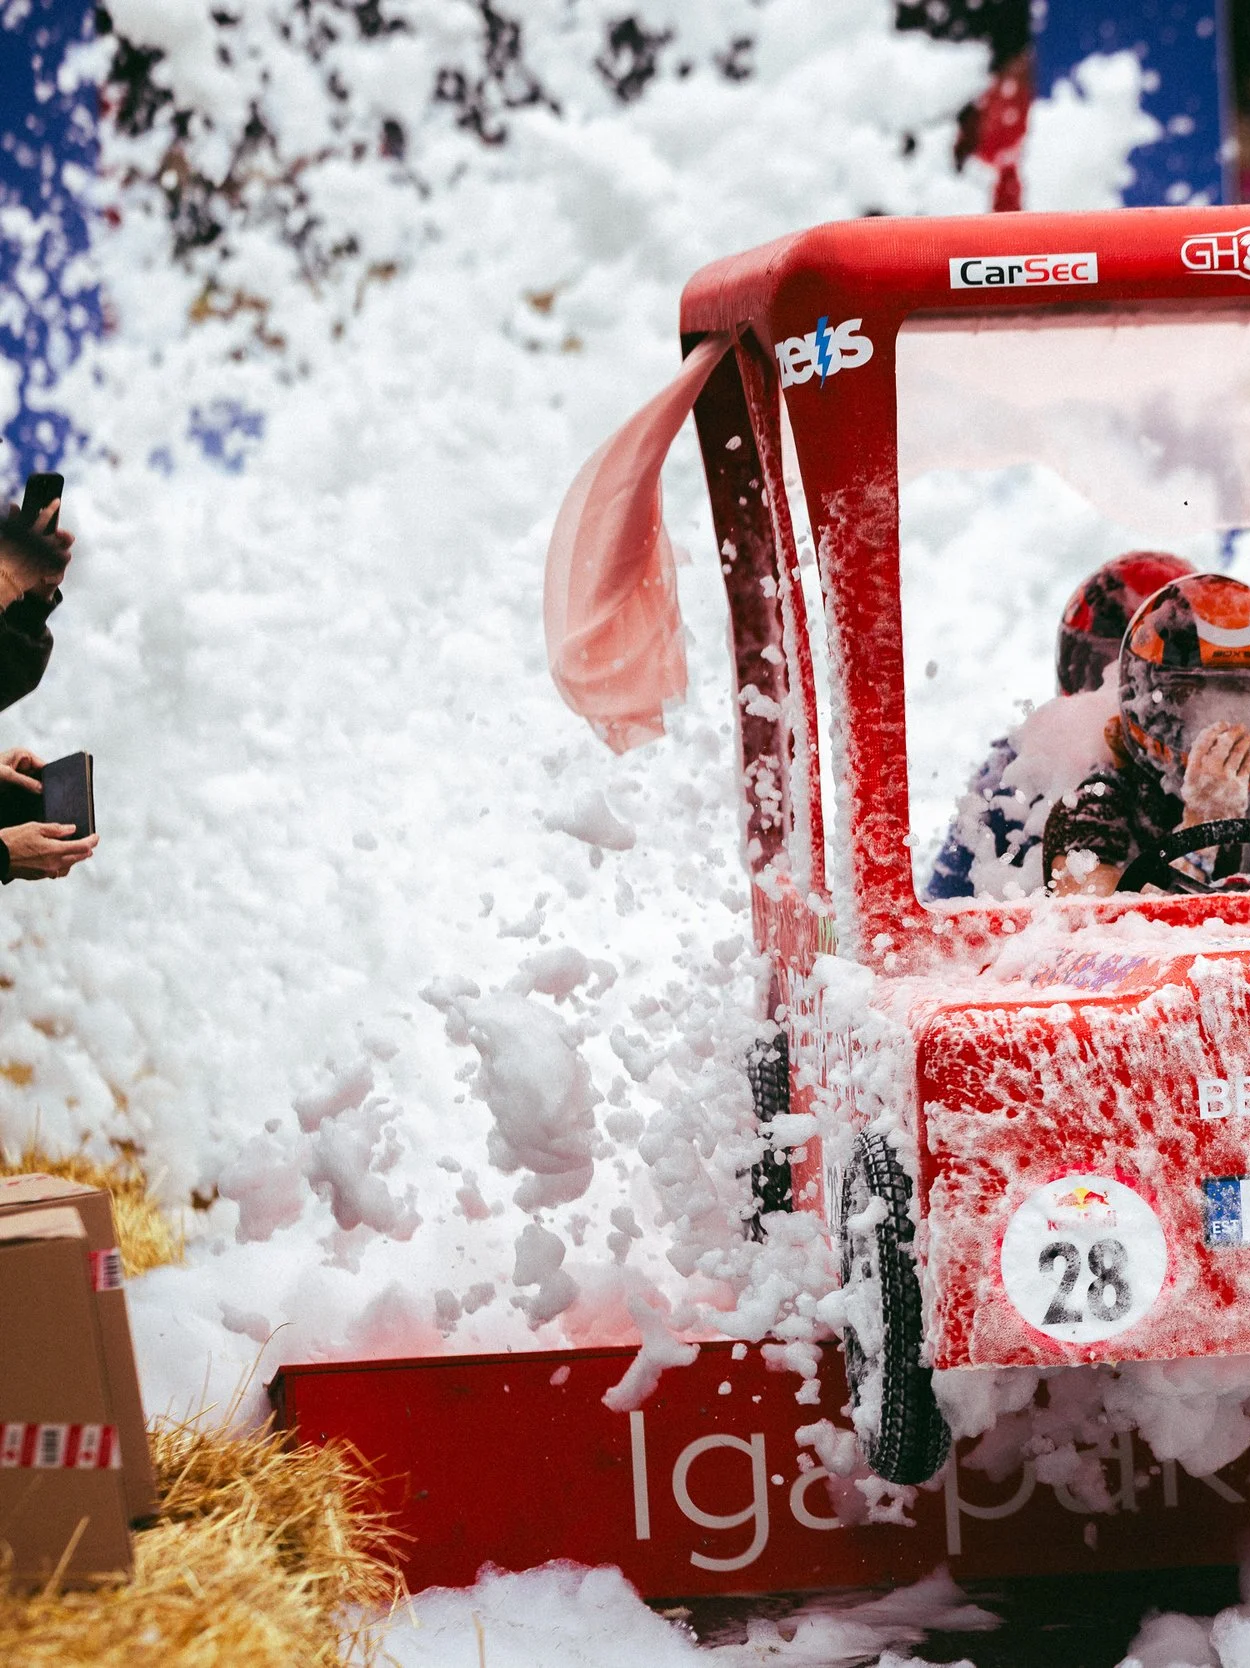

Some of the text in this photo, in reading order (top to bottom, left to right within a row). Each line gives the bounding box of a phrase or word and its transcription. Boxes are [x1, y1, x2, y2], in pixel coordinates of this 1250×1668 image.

[960, 258, 1089, 285] CarSec
[1212, 1219, 1238, 1234] EST
[1038, 1238, 1133, 1325] 28
